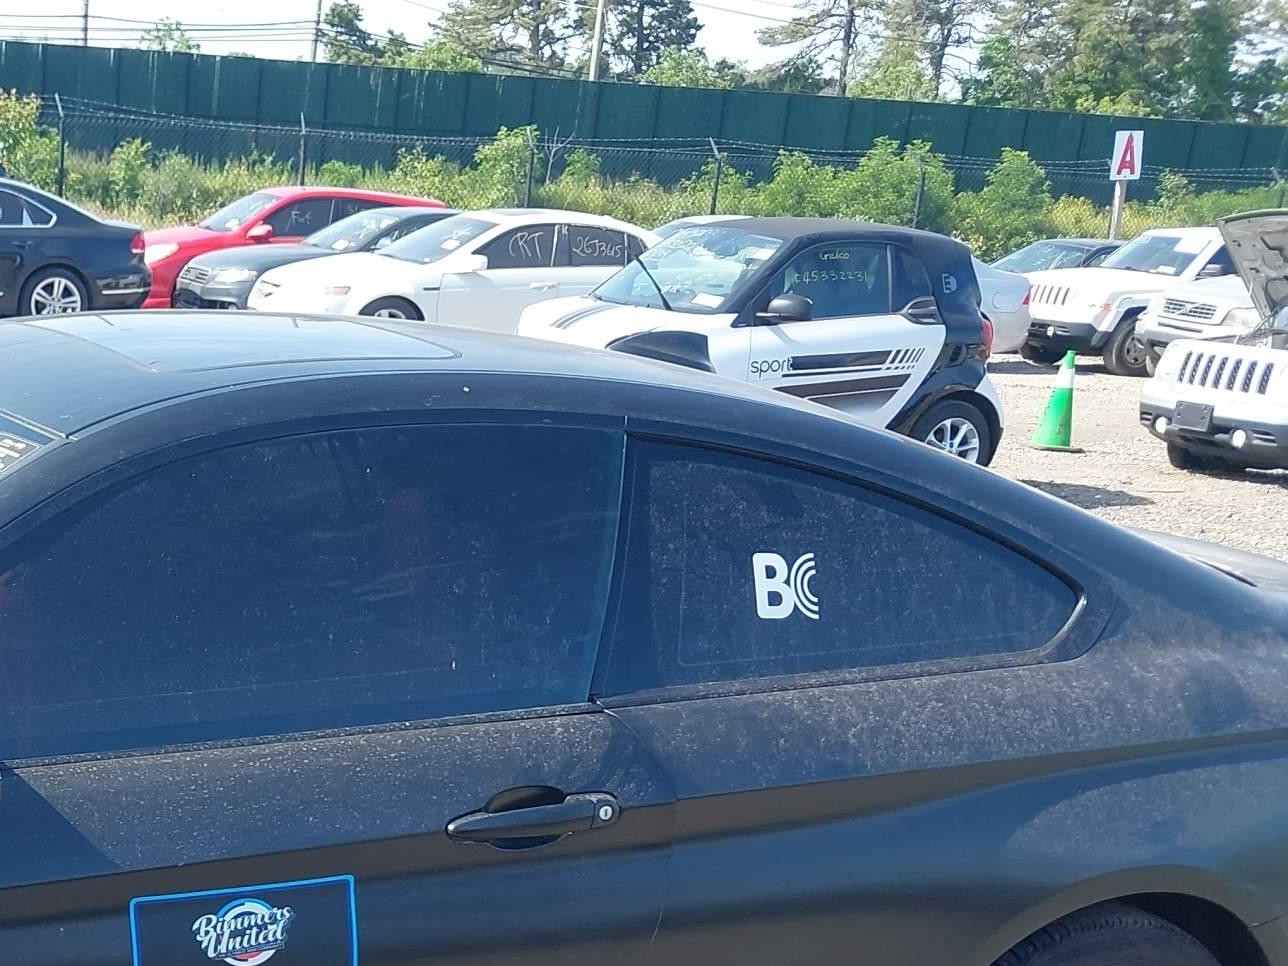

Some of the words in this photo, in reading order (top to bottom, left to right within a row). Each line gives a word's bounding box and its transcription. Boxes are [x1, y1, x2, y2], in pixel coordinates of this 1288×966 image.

[1116, 131, 1135, 176] A
[750, 356, 792, 379] sport
[192, 905, 293, 942] Bimmers
[201, 919, 286, 959] United
